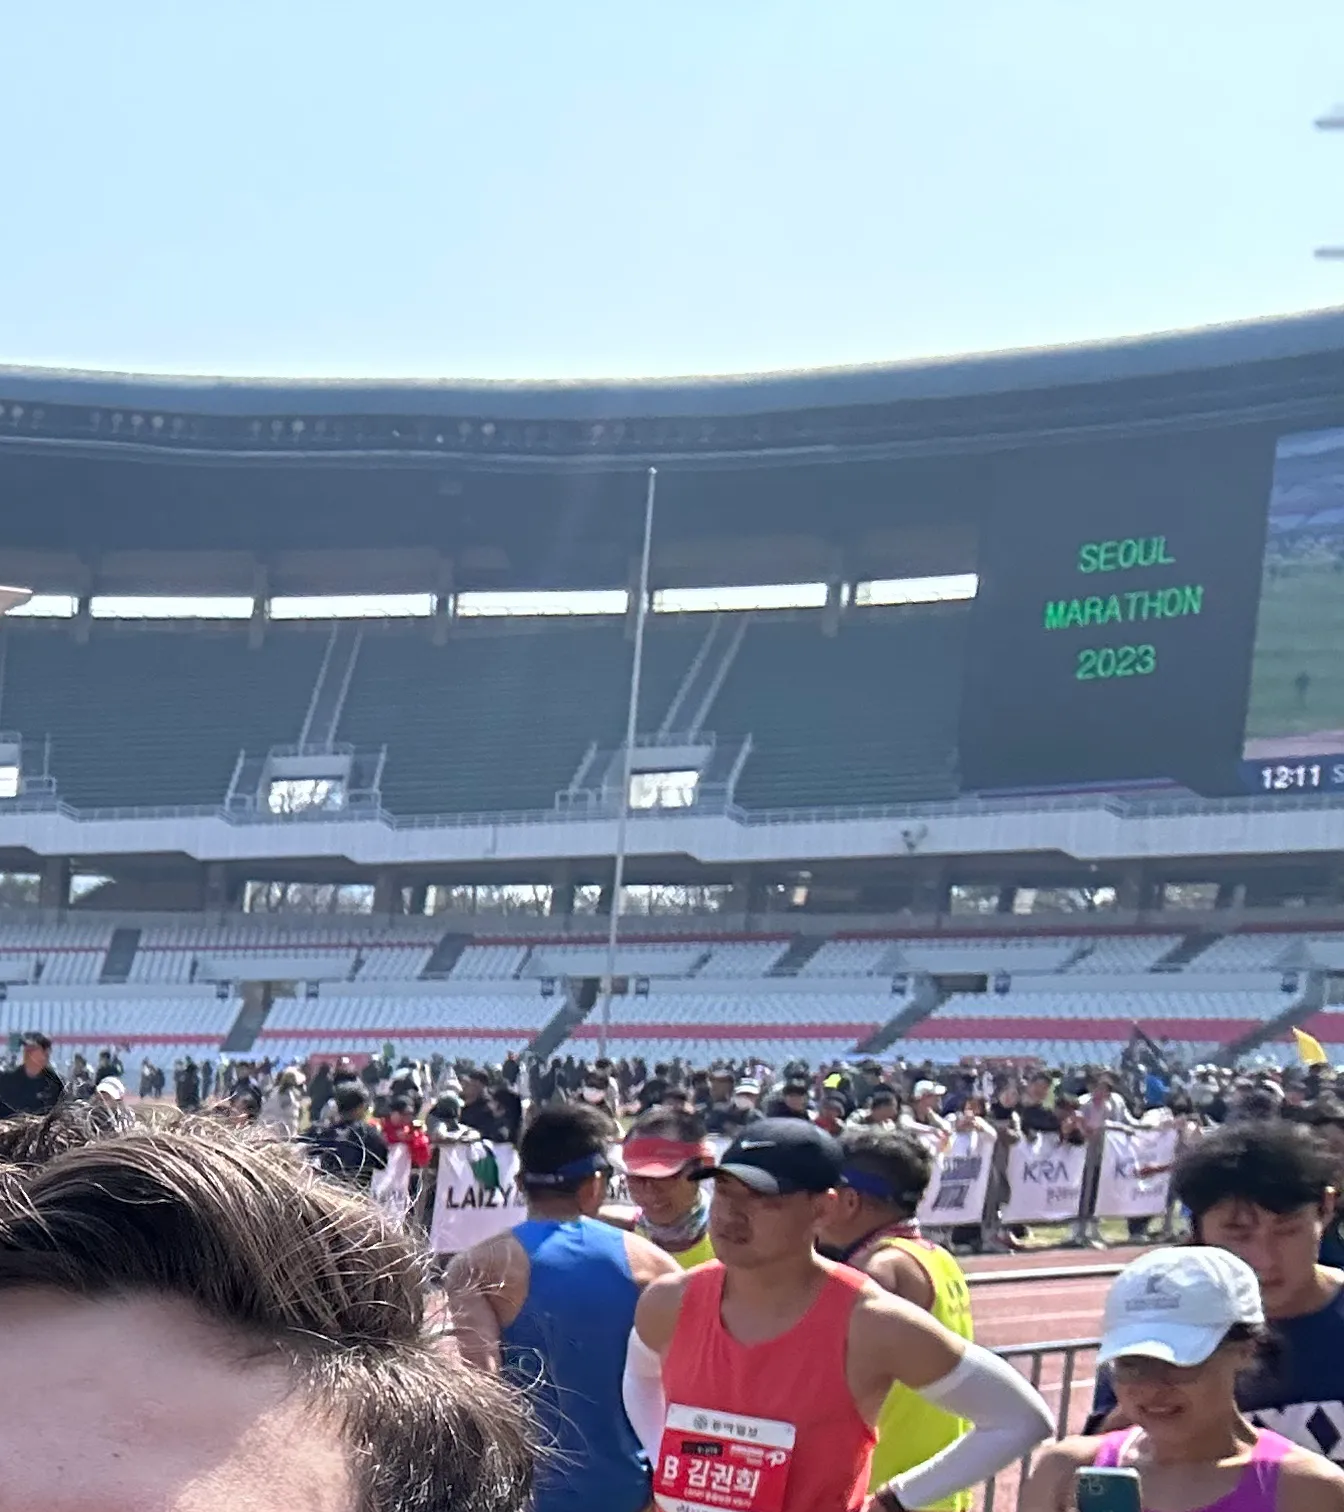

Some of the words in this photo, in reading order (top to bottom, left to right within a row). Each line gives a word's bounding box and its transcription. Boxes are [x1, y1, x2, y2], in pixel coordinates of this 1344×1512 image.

[1078, 535, 1176, 575] SEOUL
[1043, 585, 1203, 630] MARATHON
[1075, 646, 1156, 681] 2023
[1023, 1161, 1070, 1184] KRA
[663, 1455, 680, 1481] B
